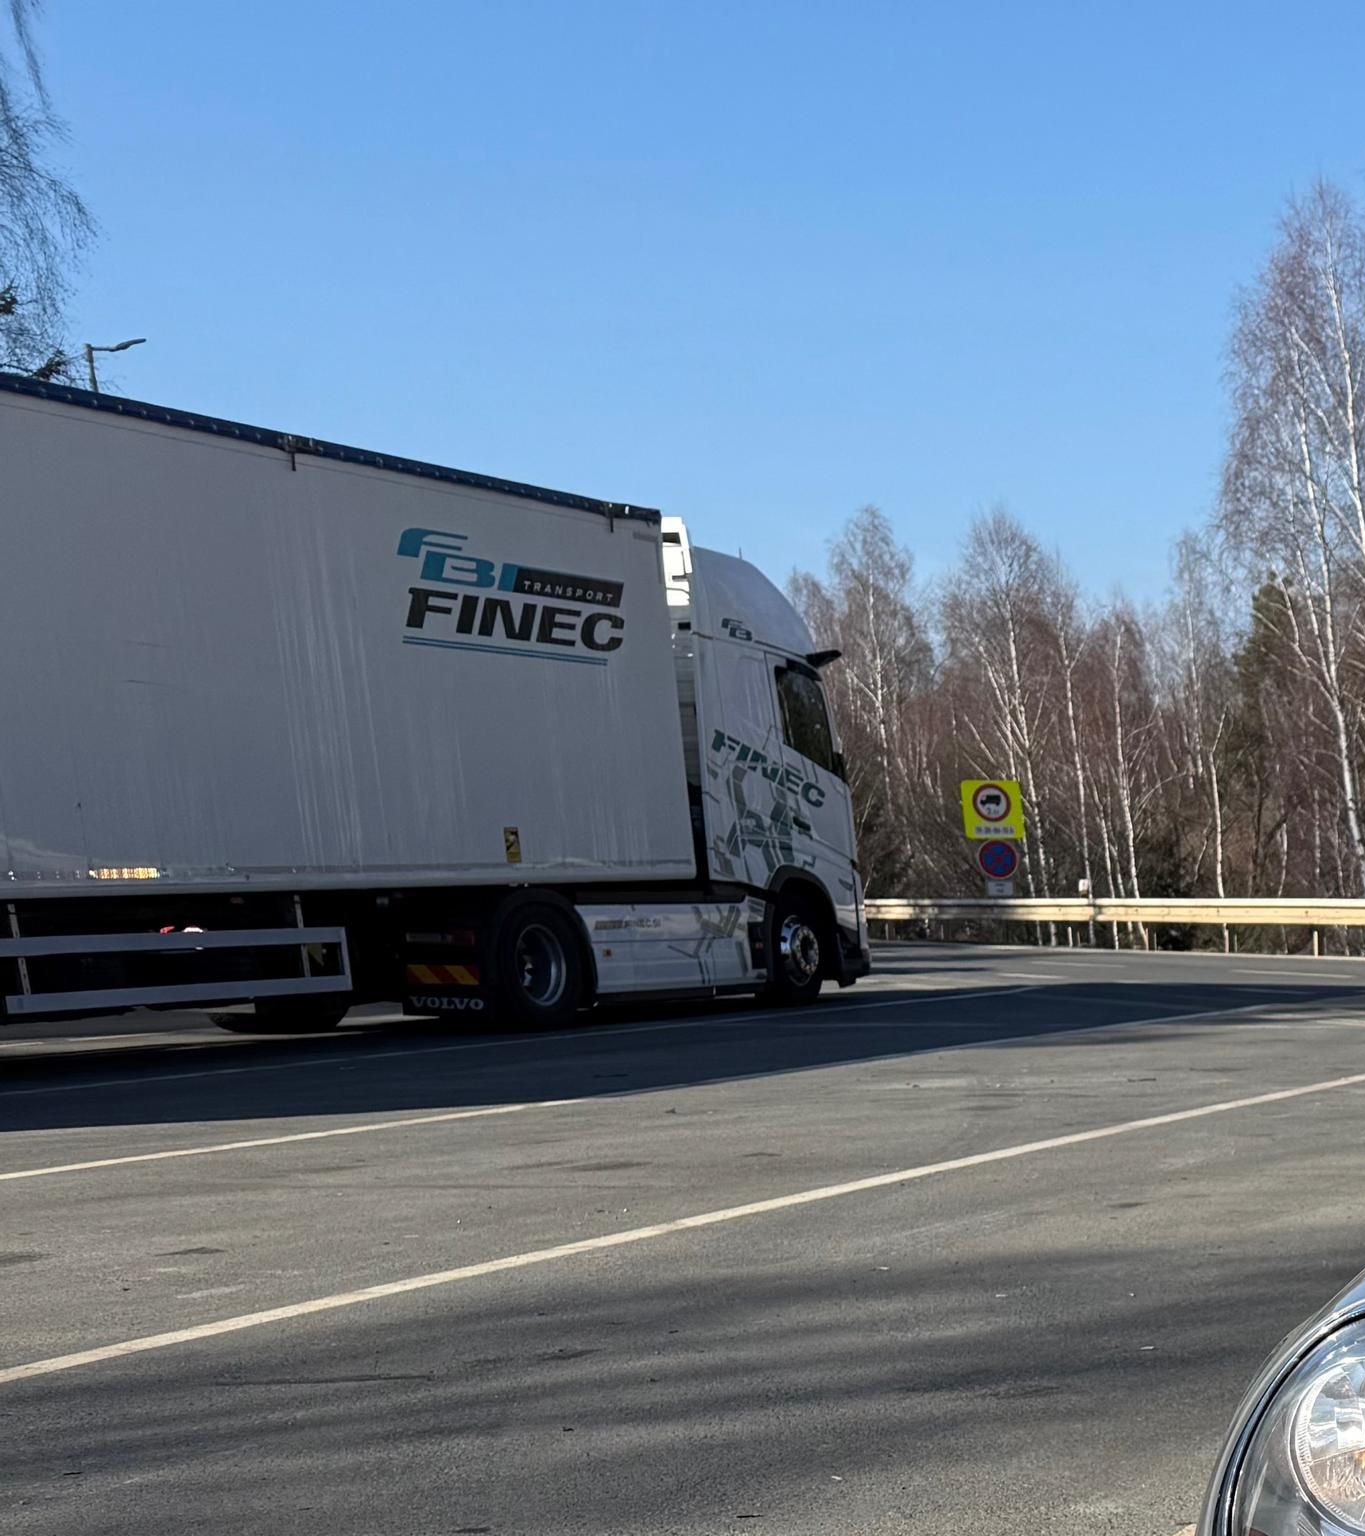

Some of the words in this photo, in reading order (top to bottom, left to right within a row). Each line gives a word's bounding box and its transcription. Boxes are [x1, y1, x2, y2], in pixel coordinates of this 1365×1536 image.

[523, 580, 615, 603] TRANSPORT
[405, 587, 625, 652] FINEC
[711, 729, 826, 808] FINEC
[408, 994, 485, 1011] VOLVO
